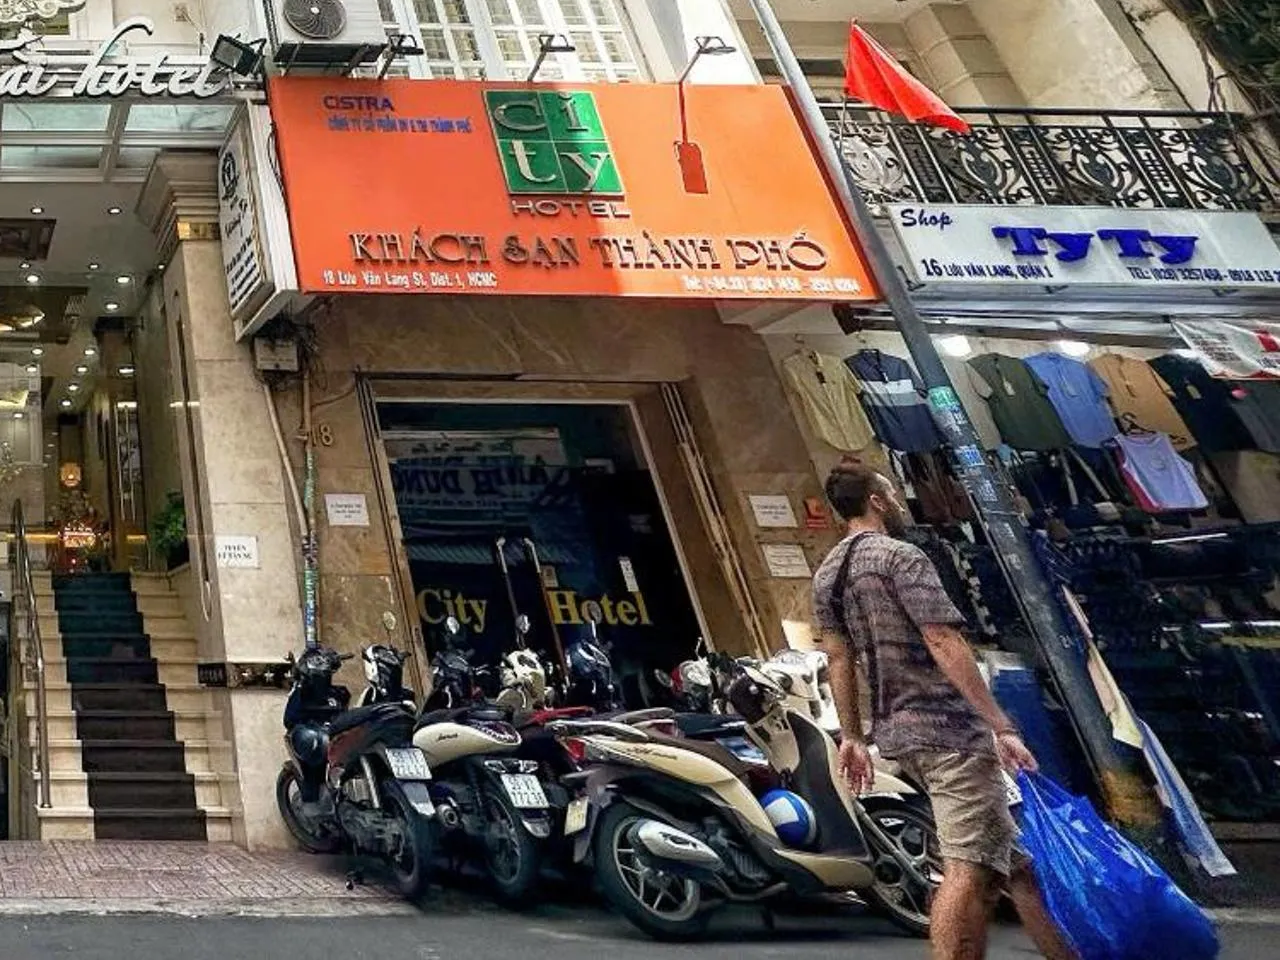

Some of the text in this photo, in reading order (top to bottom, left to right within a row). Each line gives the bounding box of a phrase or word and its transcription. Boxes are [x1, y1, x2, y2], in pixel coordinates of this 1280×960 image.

[72, 16, 229, 98] hotel
[511, 199, 631, 219] HOTEL
[900, 208, 953, 230] Shop
[348, 225, 490, 265] KHÁCH
[589, 230, 721, 270] THÀNH
[726, 231, 827, 271] PHỐ
[921, 258, 943, 277] 16
[418, 589, 654, 634] City Hotel
